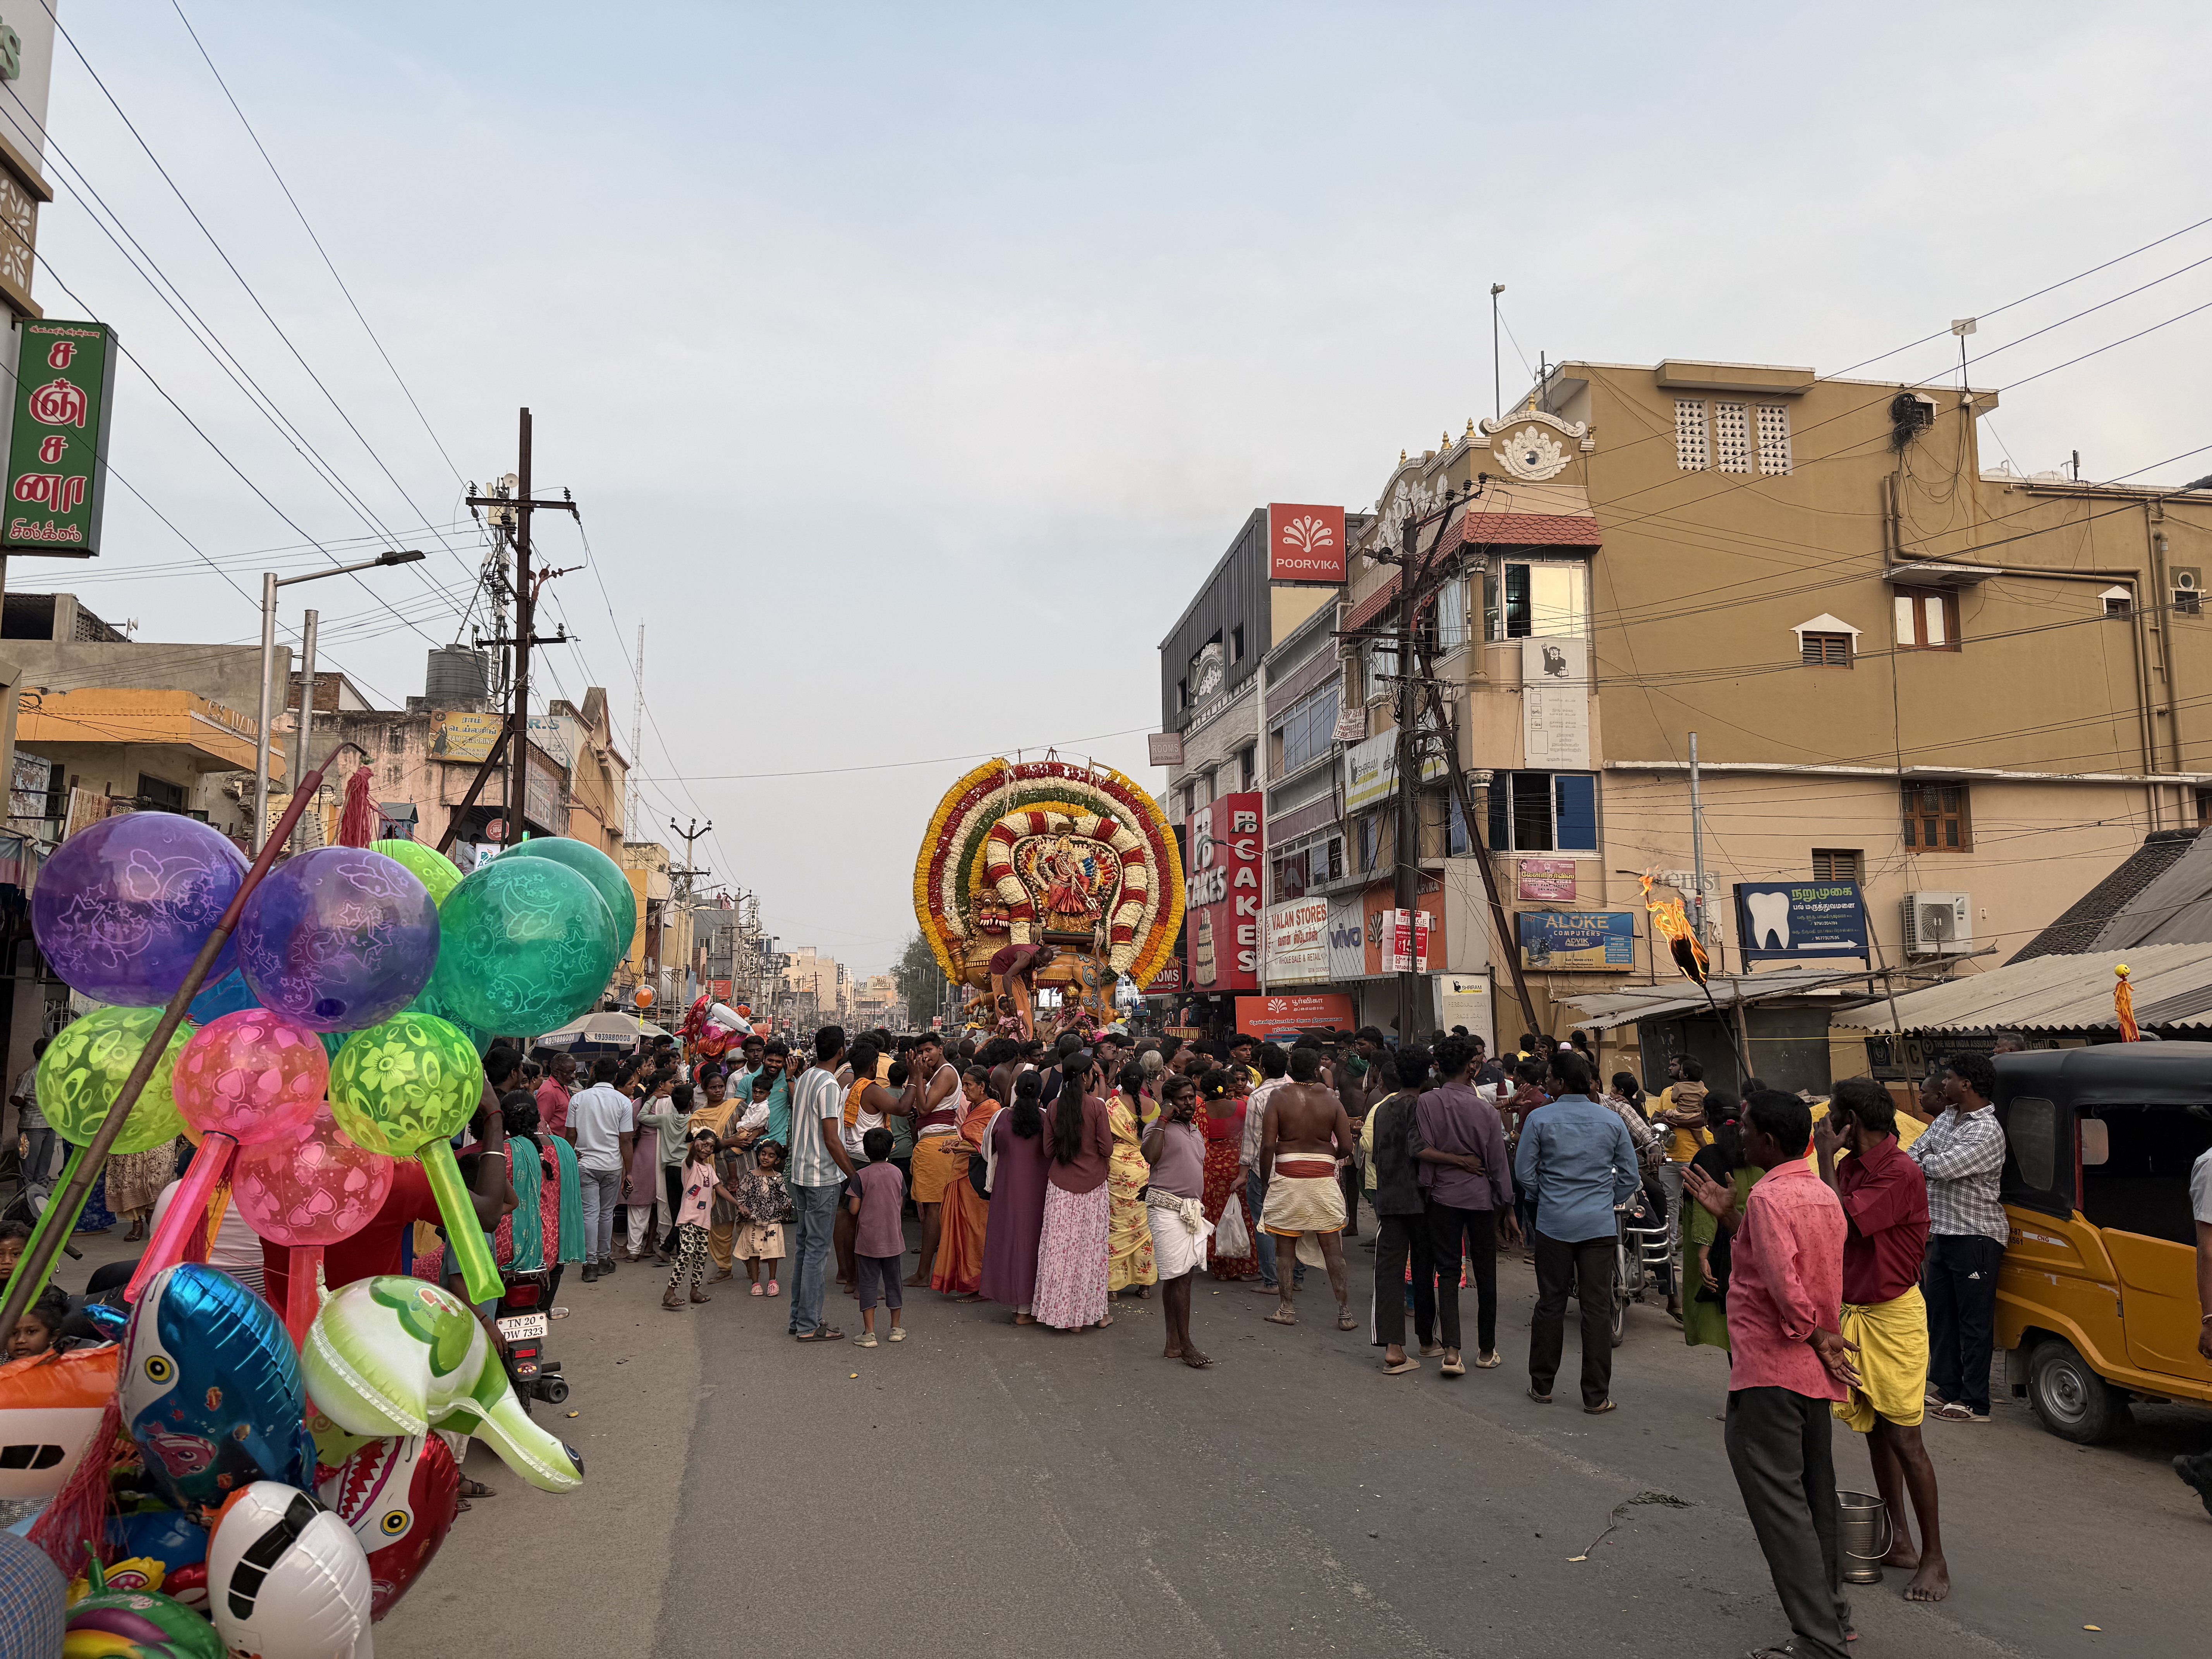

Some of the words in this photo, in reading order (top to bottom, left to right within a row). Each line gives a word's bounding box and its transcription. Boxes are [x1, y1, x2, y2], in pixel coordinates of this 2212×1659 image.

[1276, 558, 1340, 570] POORVIKA
[462, 736, 495, 744] TAILORING
[1152, 744, 1179, 754] ROOMS
[1185, 865, 1228, 910] CAKES
[1791, 886, 1853, 902] நறுமுகை
[1233, 839, 1258, 972] CAKES
[1805, 902, 1855, 912] மருத்துவமனை
[1272, 910, 1294, 931] VALAN
[1296, 903, 1327, 926] STORES
[1545, 915, 1609, 929] ALOKE
[1278, 956, 1291, 965] WHOLE
[1292, 955, 1301, 963] SALE
[1307, 952, 1321, 961] RETAIL
[1292, 997, 1323, 1006] பூர்விகா
[594, 1033, 630, 1041] 8939880008
[1970, 1040, 1997, 1048] ASSURANC
[508, 1318, 521, 1328] TN
[524, 1316, 536, 1326] 20
[503, 1330, 520, 1340] DW
[523, 1327, 543, 1337] 7323
